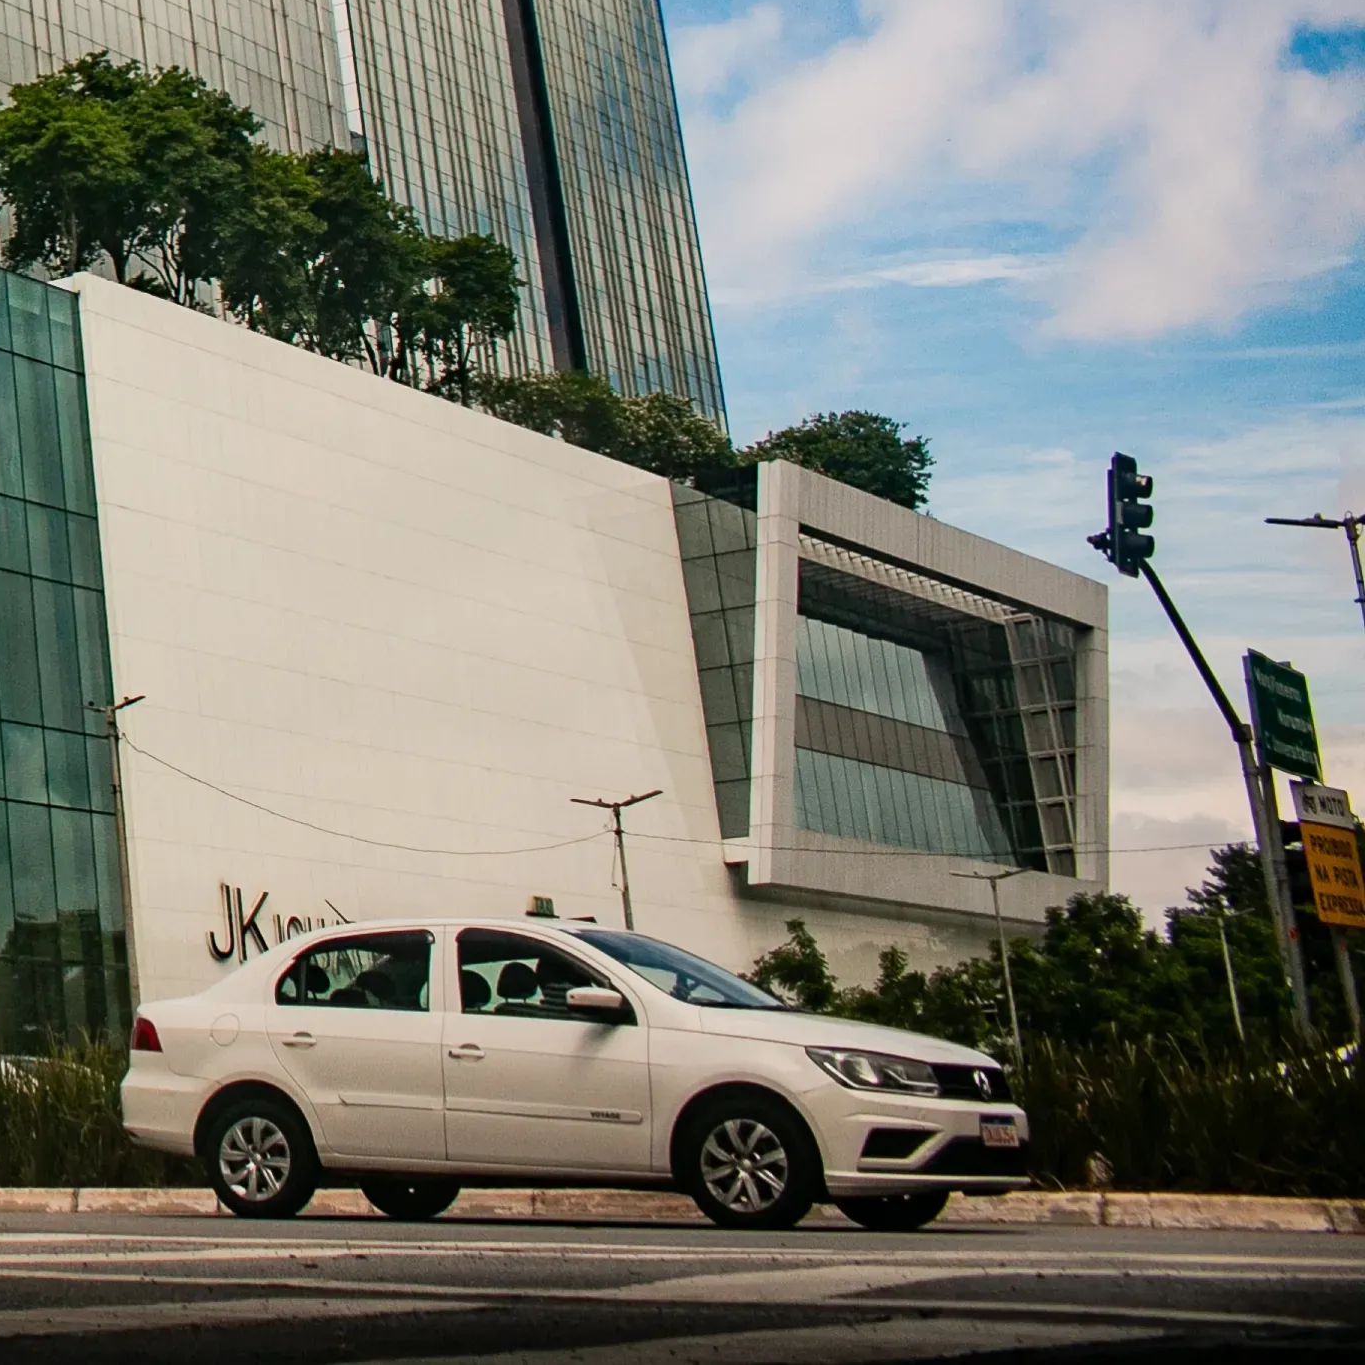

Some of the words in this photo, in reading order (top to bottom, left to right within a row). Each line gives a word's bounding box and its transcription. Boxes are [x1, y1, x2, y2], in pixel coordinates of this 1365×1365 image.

[1317, 795, 1345, 817] MOTO
[1310, 834, 1354, 859] PROIBIDO
[1314, 863, 1330, 883] NA
[1332, 865, 1359, 889] PISTA
[206, 882, 269, 964] JK
